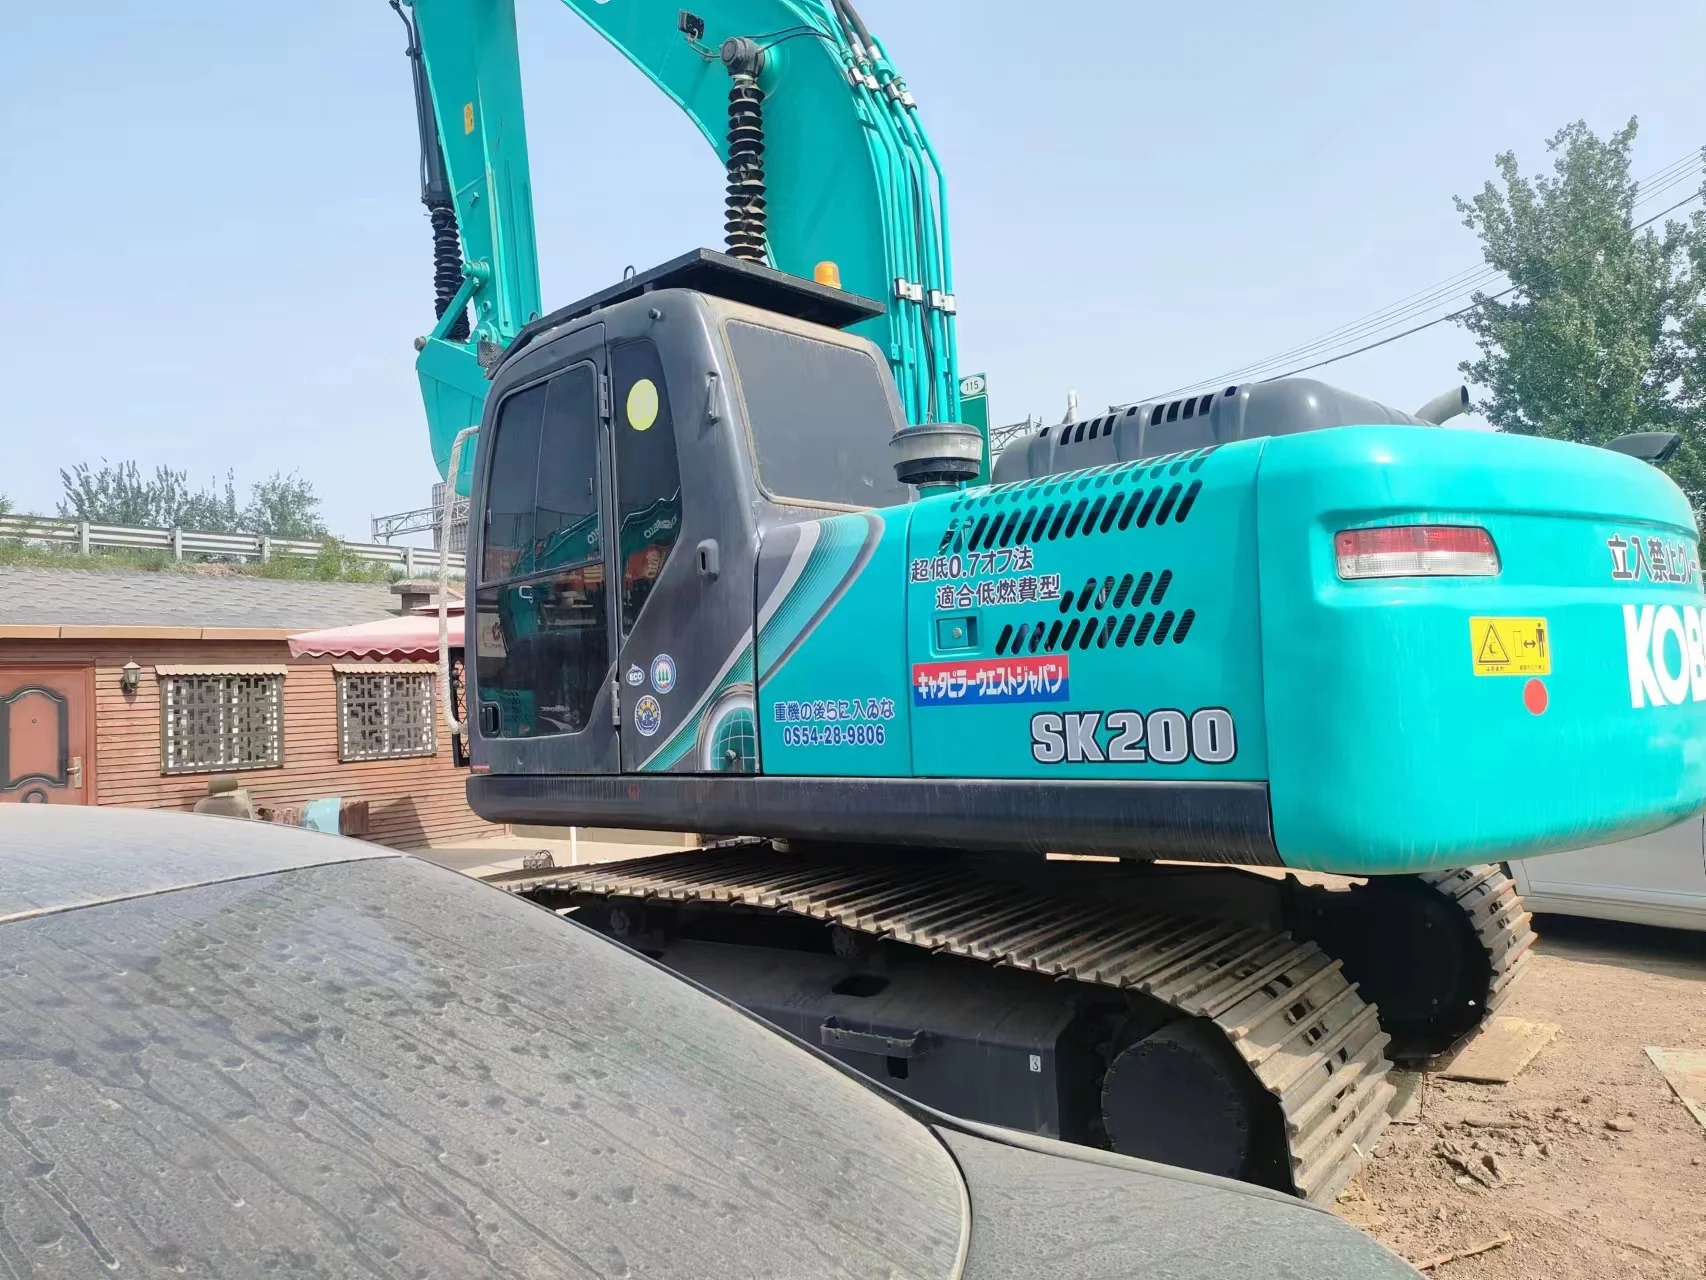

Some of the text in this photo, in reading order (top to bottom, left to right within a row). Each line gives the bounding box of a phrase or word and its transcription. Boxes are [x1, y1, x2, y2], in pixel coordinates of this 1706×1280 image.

[965, 381, 979, 391] 115
[935, 573, 1061, 610] 適合低燃費型
[629, 672, 643, 681] ECO
[1031, 707, 1237, 763] SK200
